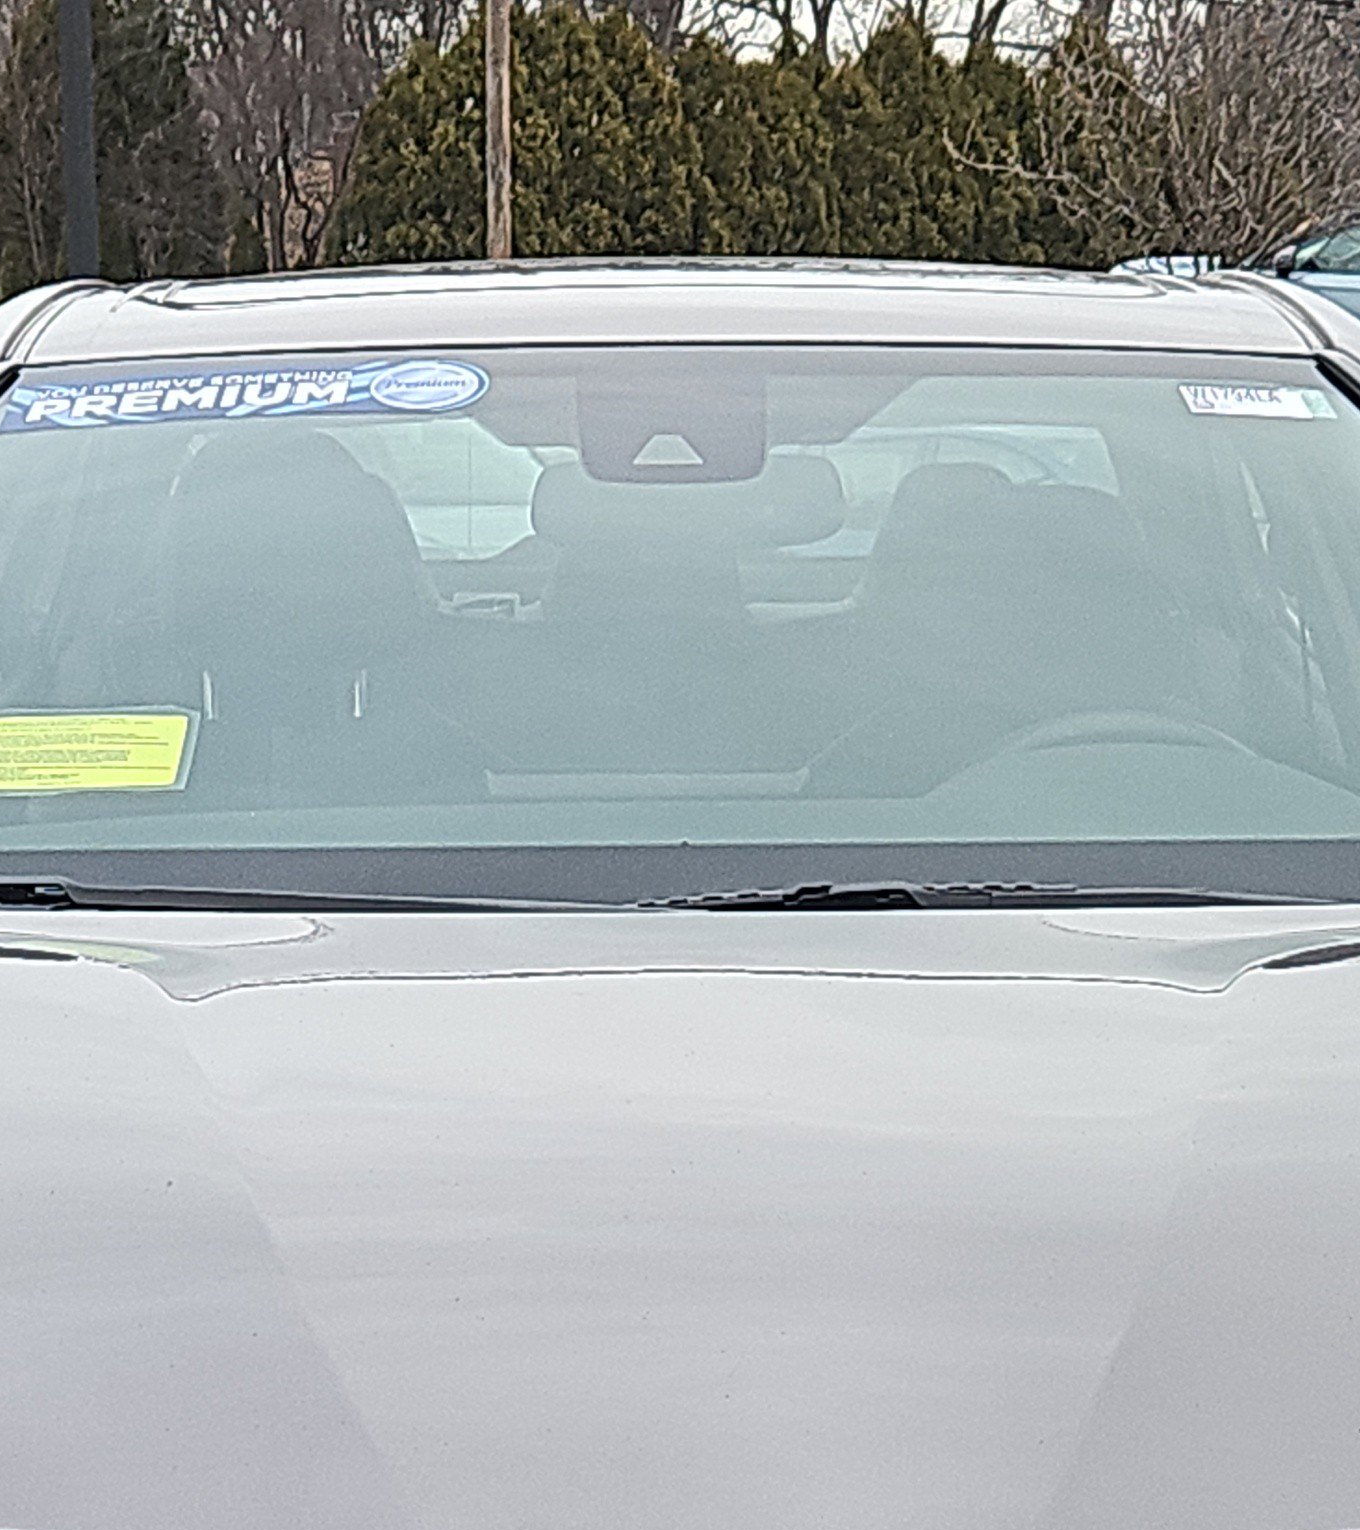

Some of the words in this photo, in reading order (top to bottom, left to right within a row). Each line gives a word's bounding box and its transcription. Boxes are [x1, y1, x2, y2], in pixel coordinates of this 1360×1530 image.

[24, 380, 350, 423] PREMIUM
[39, 383, 87, 399] YOU
[93, 376, 204, 395] DESERVE
[210, 370, 353, 386] SOMETHING
